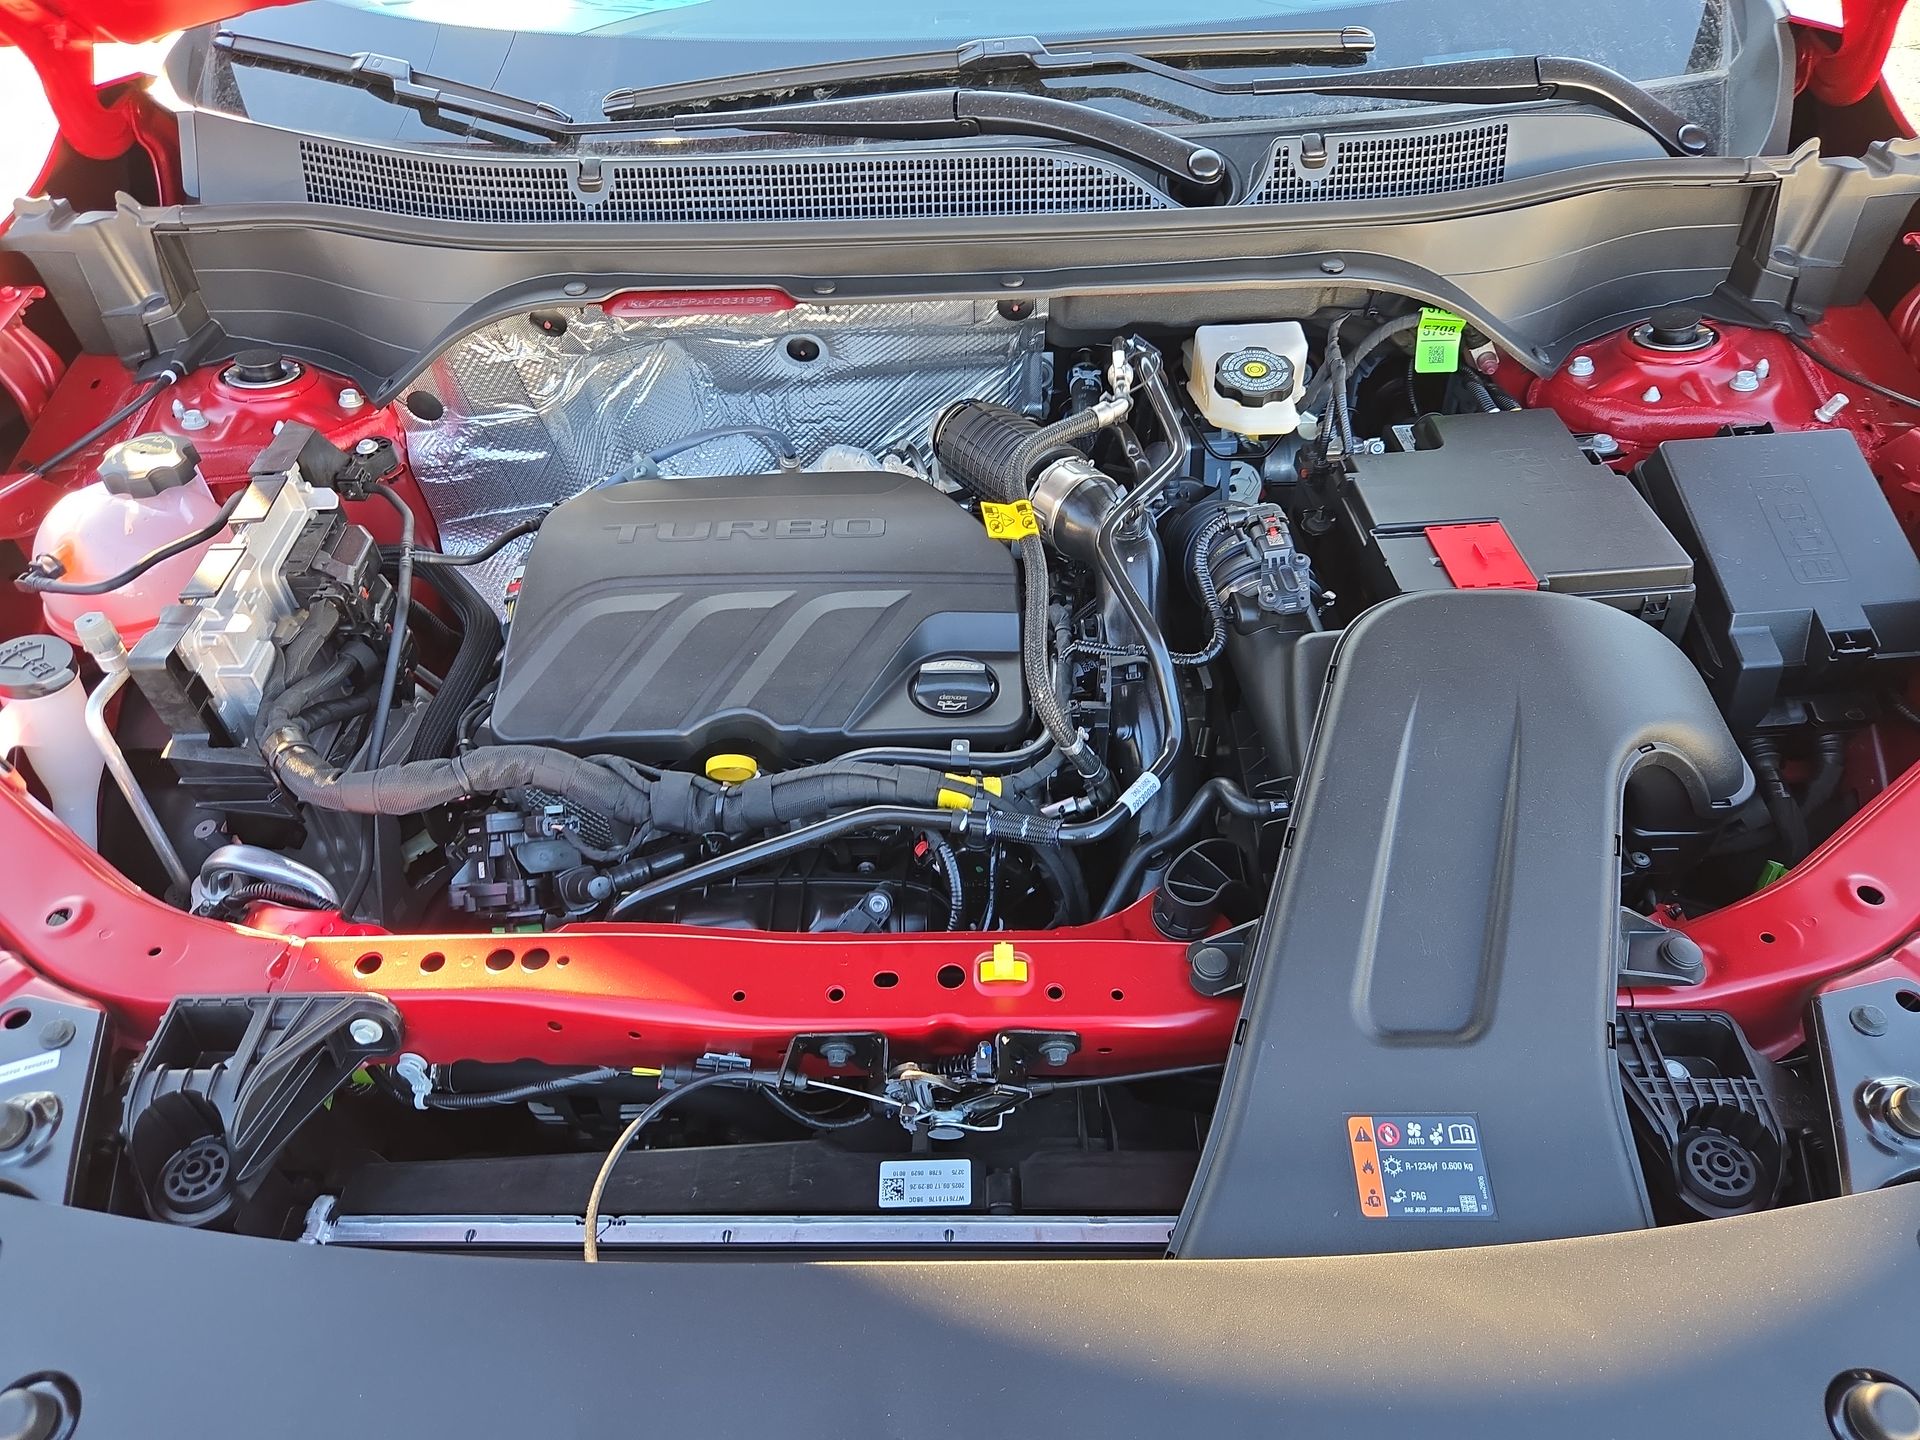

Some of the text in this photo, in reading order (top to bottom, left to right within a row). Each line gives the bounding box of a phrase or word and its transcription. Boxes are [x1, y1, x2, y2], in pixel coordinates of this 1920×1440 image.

[603, 517, 887, 544] TURBO
[1405, 1162, 1474, 1173] R-1234yf 0.600 kg
[1411, 1192, 1427, 1200] PAG
